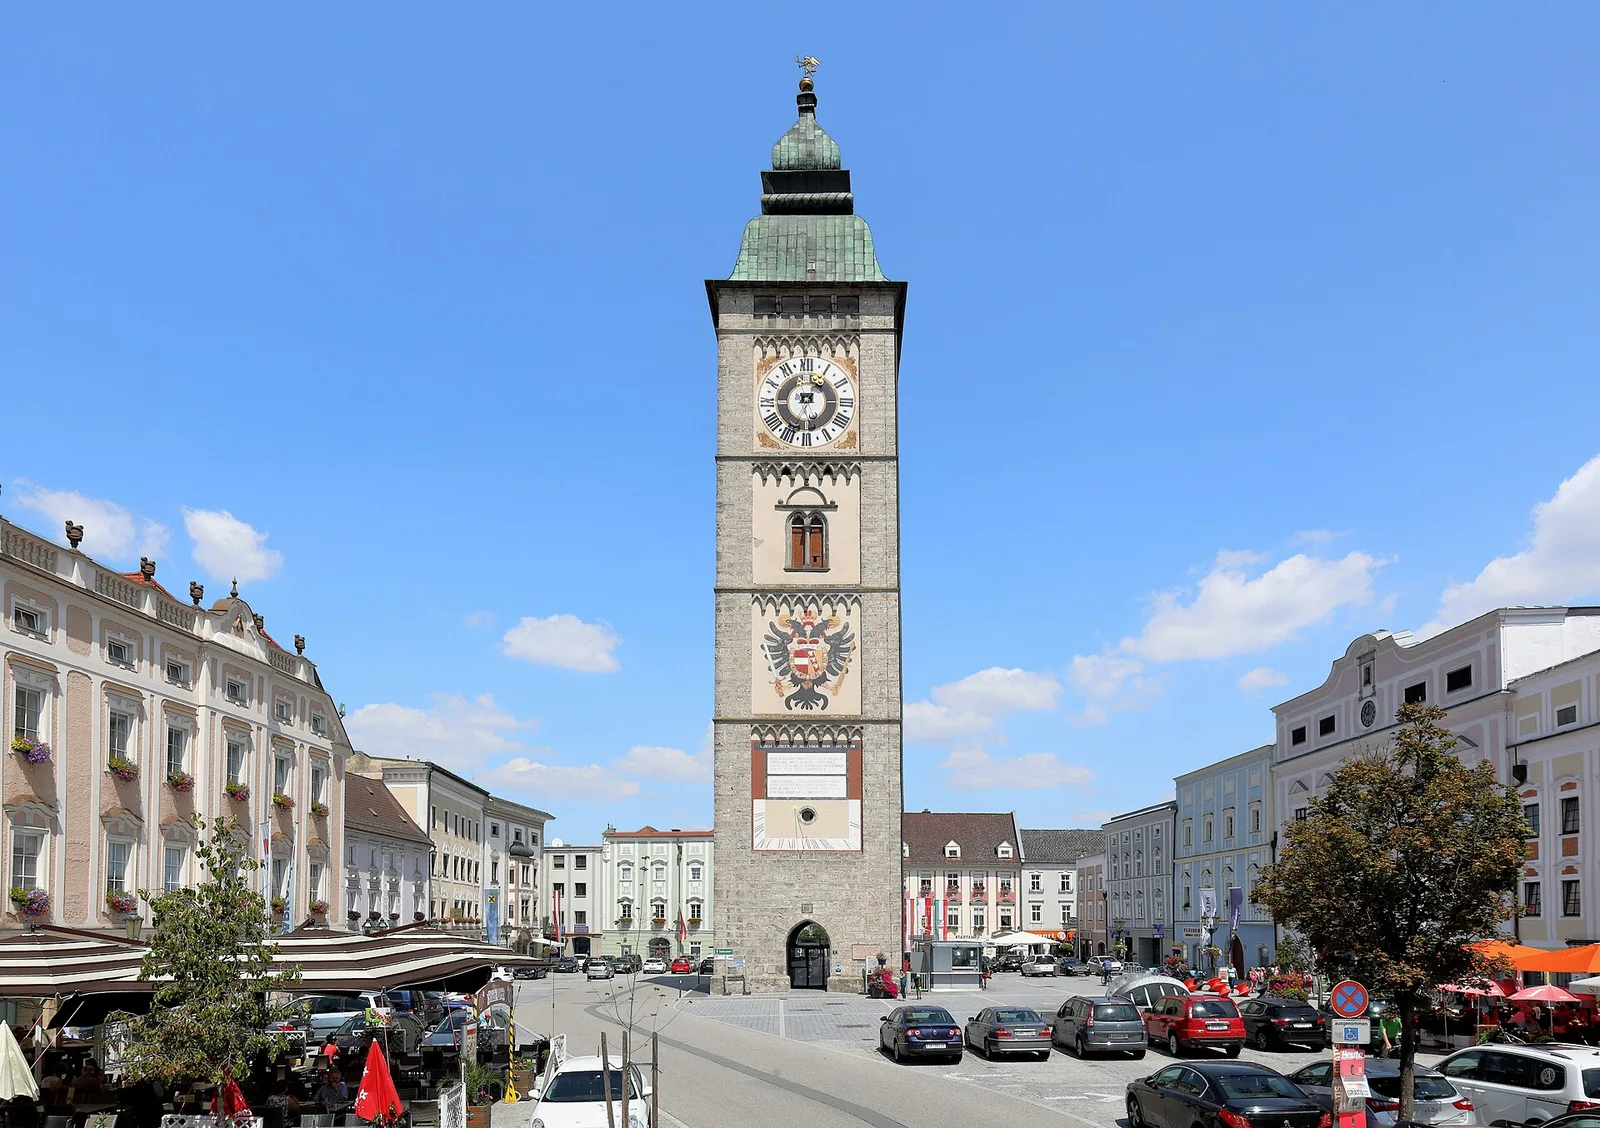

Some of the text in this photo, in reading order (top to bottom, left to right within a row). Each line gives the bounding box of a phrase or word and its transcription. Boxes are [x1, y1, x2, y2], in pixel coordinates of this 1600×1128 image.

[779, 362, 793, 378] XI
[800, 358, 814, 371] XII
[823, 363, 831, 376] I
[765, 378, 780, 390] X
[833, 377, 849, 389] II
[760, 396, 775, 407] IX
[839, 397, 853, 408] III
[831, 411, 850, 429] IIII
[801, 432, 812, 446] VI
[1341, 1050, 1364, 1059] Heute
